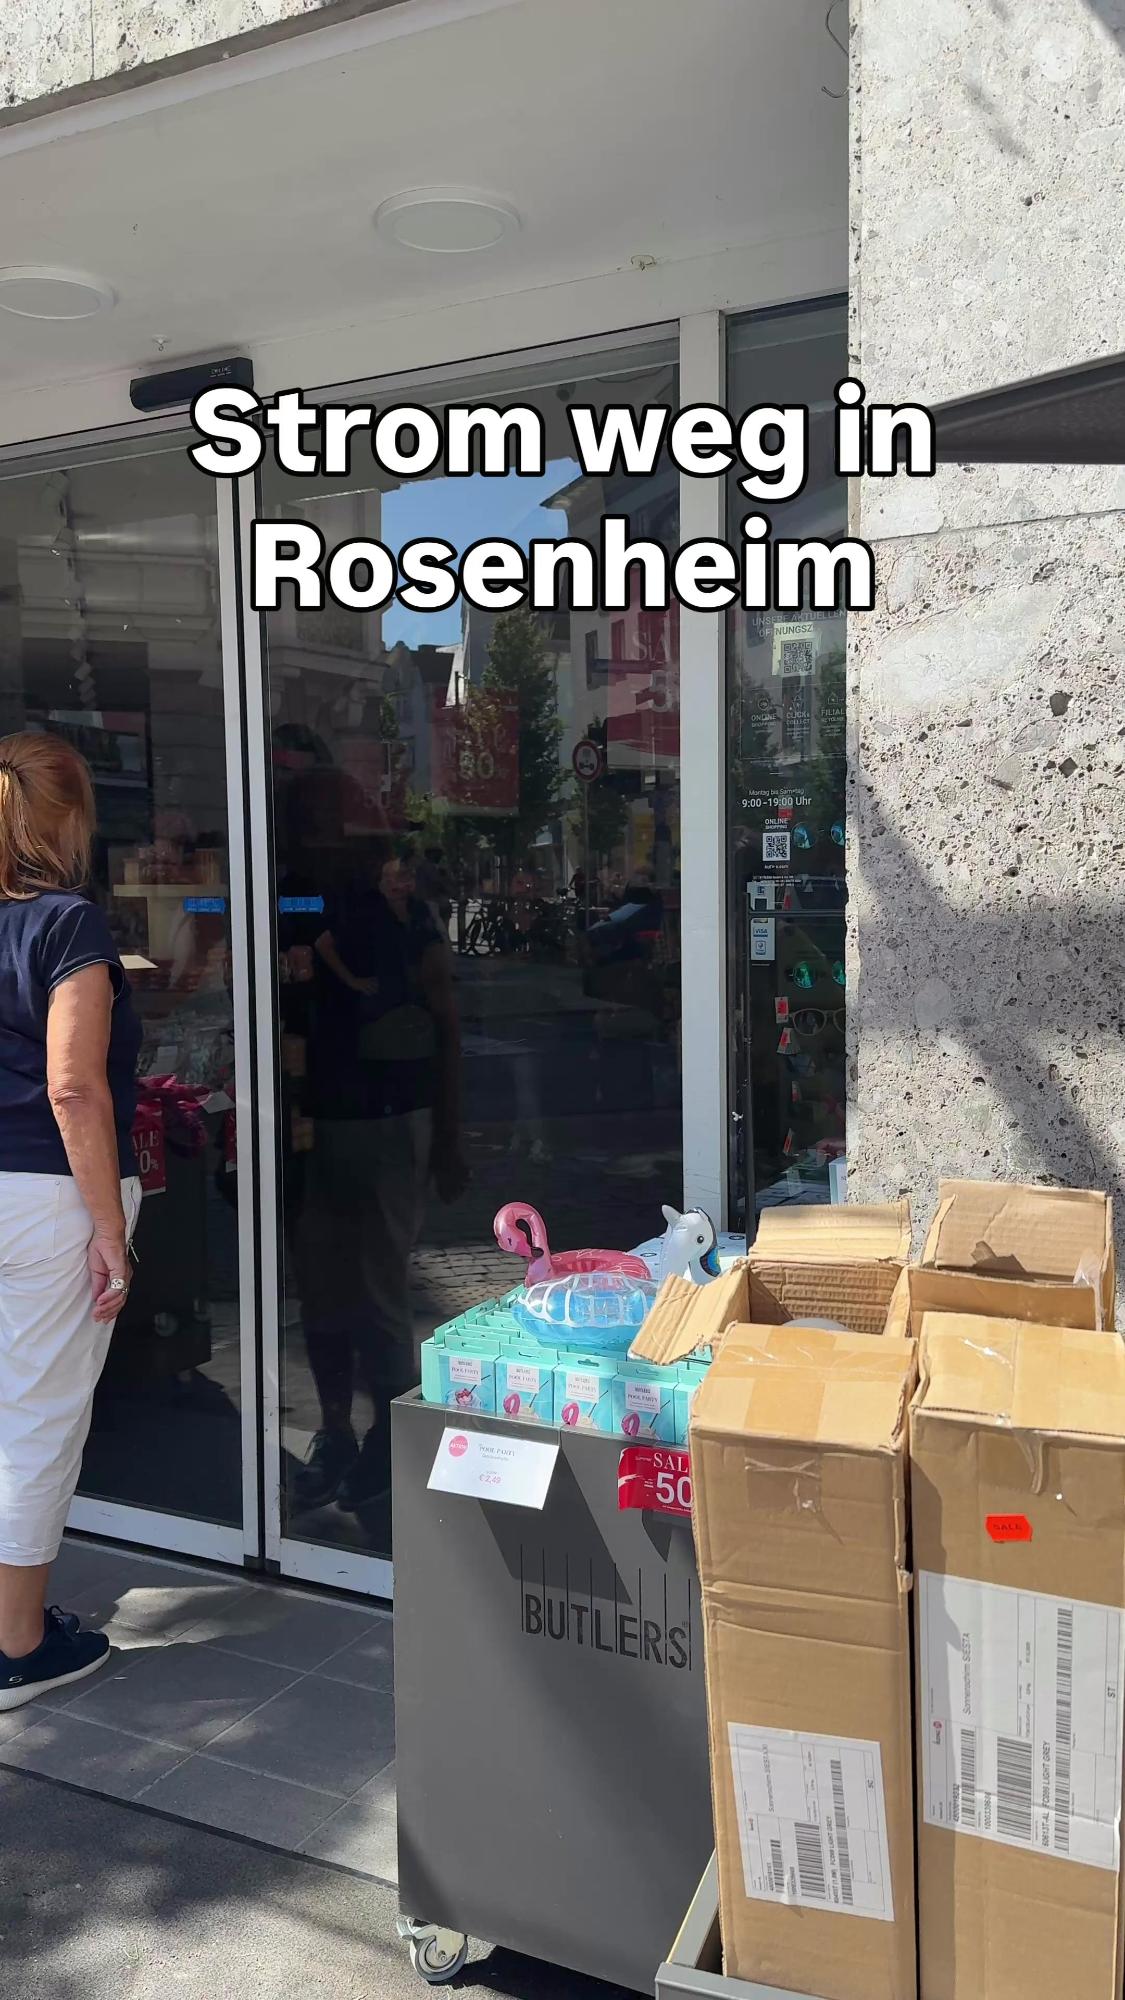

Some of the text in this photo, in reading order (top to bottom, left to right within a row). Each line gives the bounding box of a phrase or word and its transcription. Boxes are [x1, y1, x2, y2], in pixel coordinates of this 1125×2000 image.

[795, 796, 812, 807] Uhr
[653, 1452, 688, 1473] SAL
[525, 1593, 688, 1668] BUTLERS
[1106, 1685, 1117, 1699] ST
[1042, 1740, 1052, 1762] GREY
[1042, 1763, 1051, 1785] LIGHT
